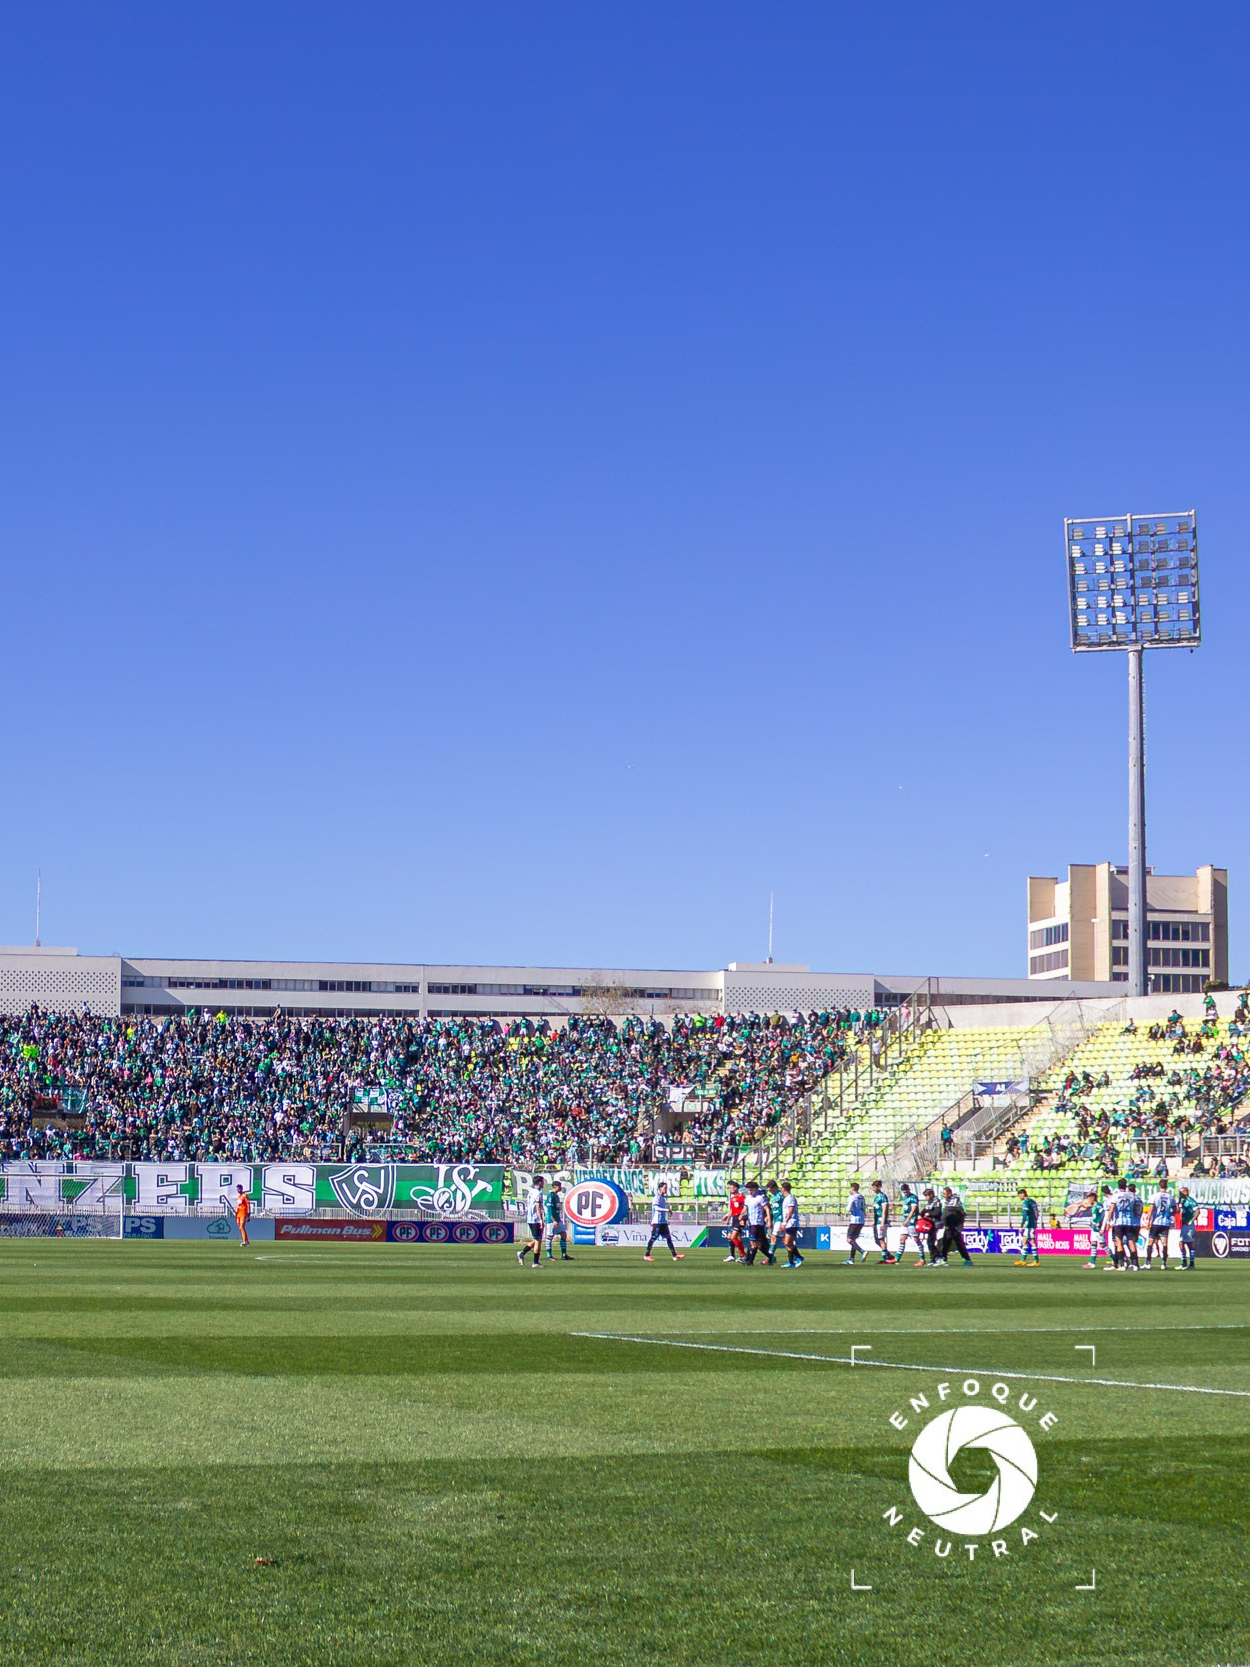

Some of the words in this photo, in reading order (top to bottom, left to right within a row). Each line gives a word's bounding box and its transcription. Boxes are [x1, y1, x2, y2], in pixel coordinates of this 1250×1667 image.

[577, 1191, 604, 1217] PF
[280, 1224, 341, 1235] Pullman
[341, 1225, 372, 1236] Bus
[623, 1229, 647, 1242] Viña
[1037, 1233, 1052, 1241] MALL
